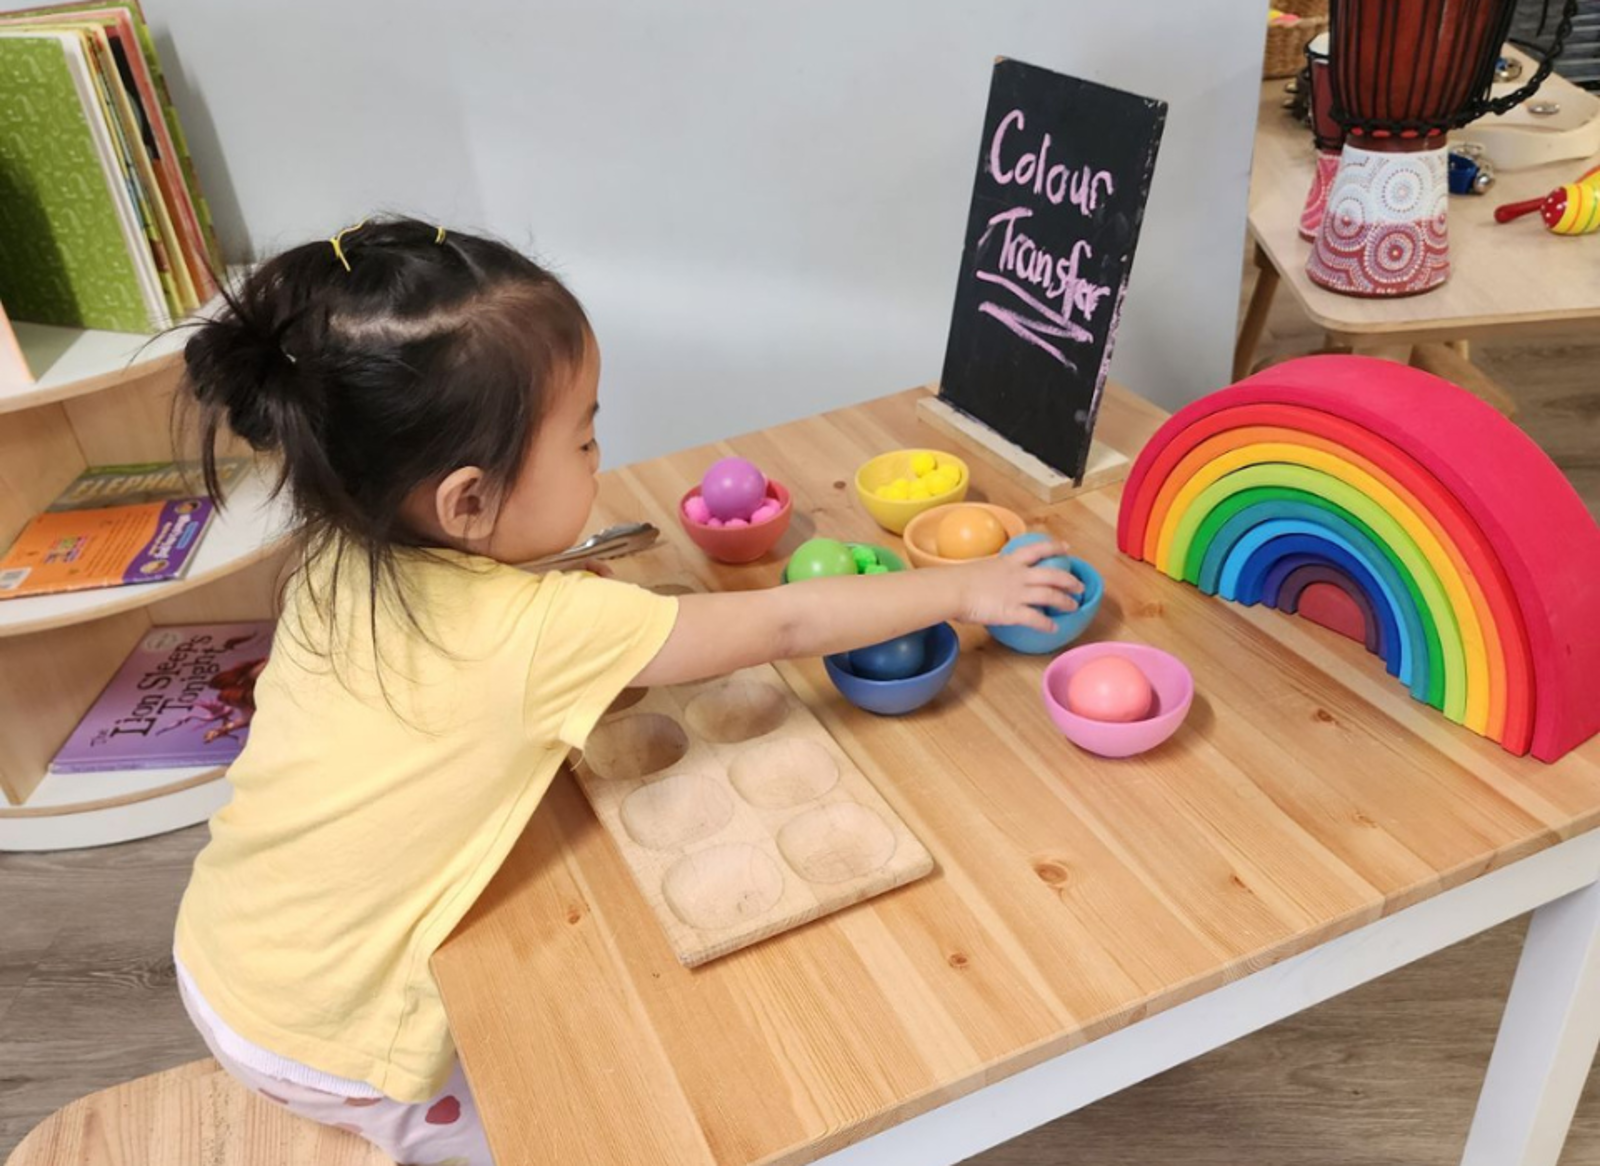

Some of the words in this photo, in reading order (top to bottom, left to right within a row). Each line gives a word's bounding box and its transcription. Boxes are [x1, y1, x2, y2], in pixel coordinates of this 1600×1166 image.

[990, 108, 1114, 216] Colour
[978, 206, 1111, 321] Transfer
[136, 635, 213, 691] Sleeps
[157, 645, 224, 715] Tonight
[110, 694, 164, 738] Lion
